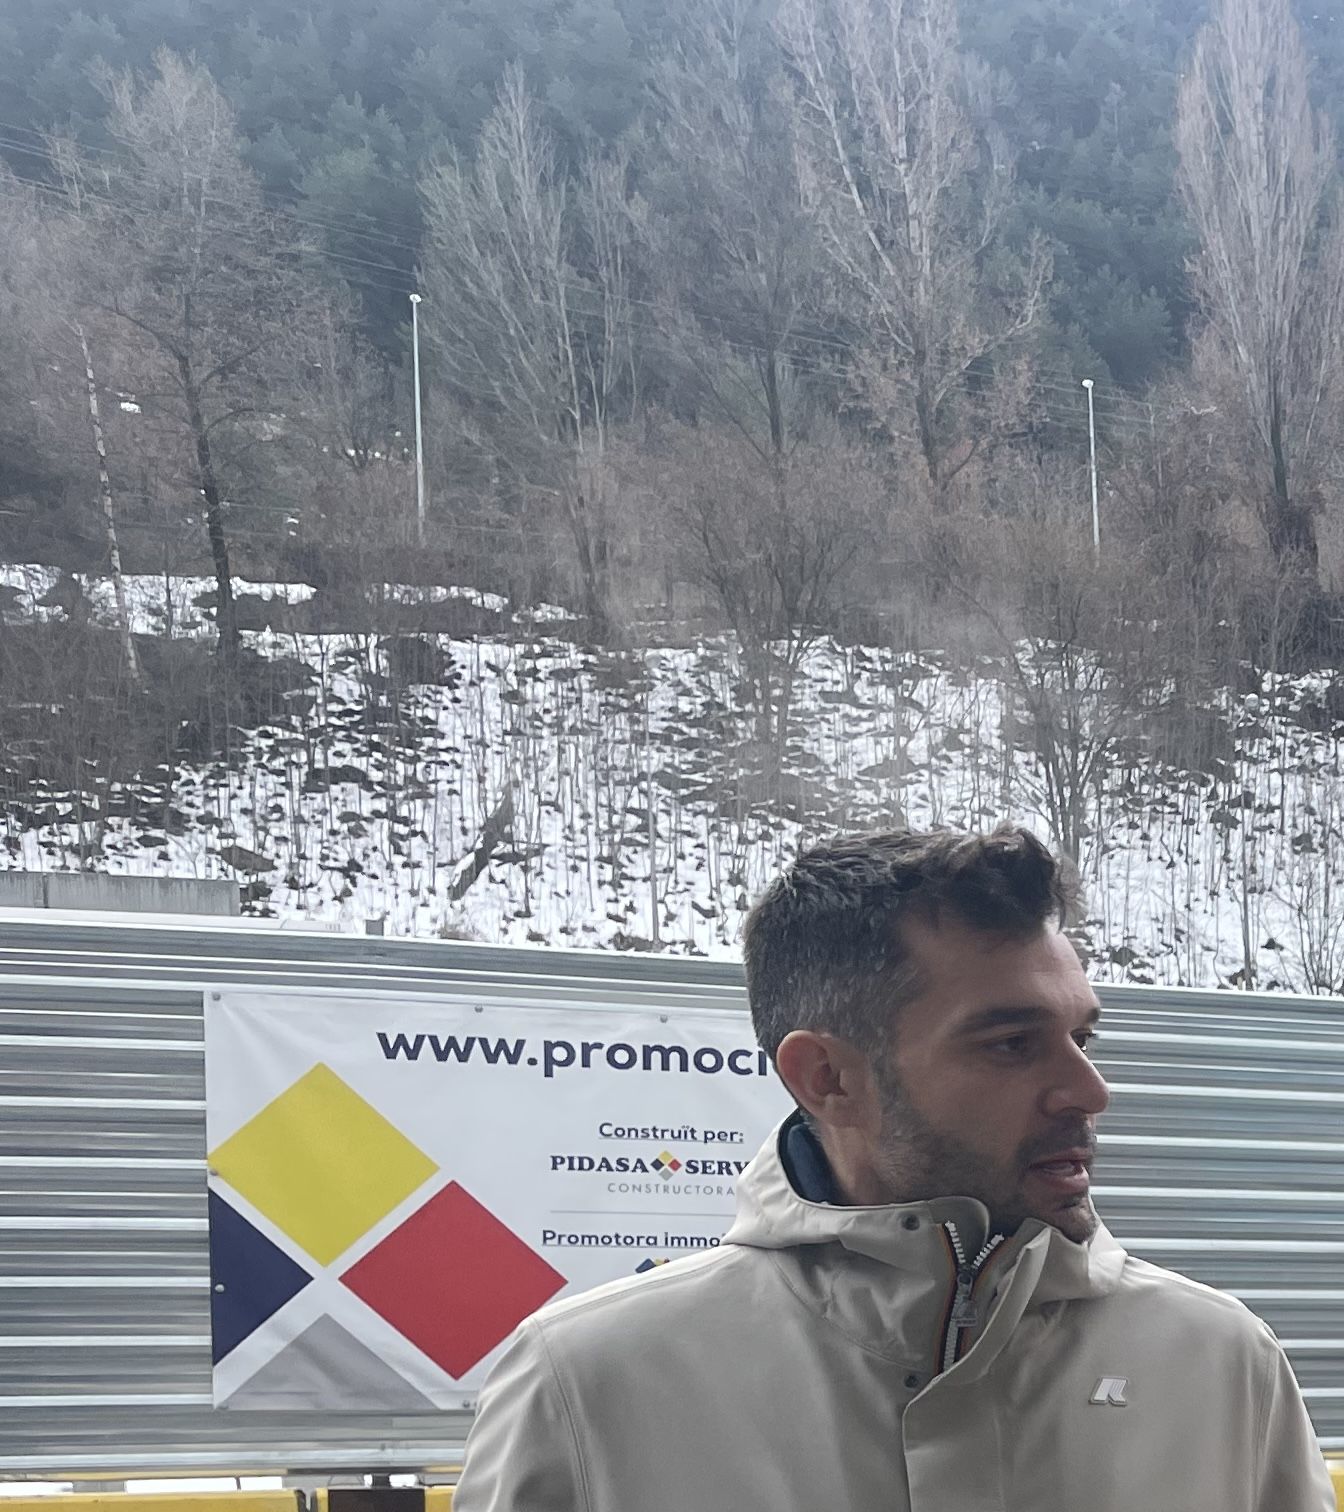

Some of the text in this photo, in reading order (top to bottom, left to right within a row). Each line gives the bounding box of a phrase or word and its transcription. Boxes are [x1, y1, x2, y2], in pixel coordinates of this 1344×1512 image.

[599, 1122, 744, 1144] Construït per:
[550, 1155, 649, 1173] PIDASA
[607, 1182, 735, 1196] CONSTRUCTORA
[542, 1229, 658, 1247] Promotora
